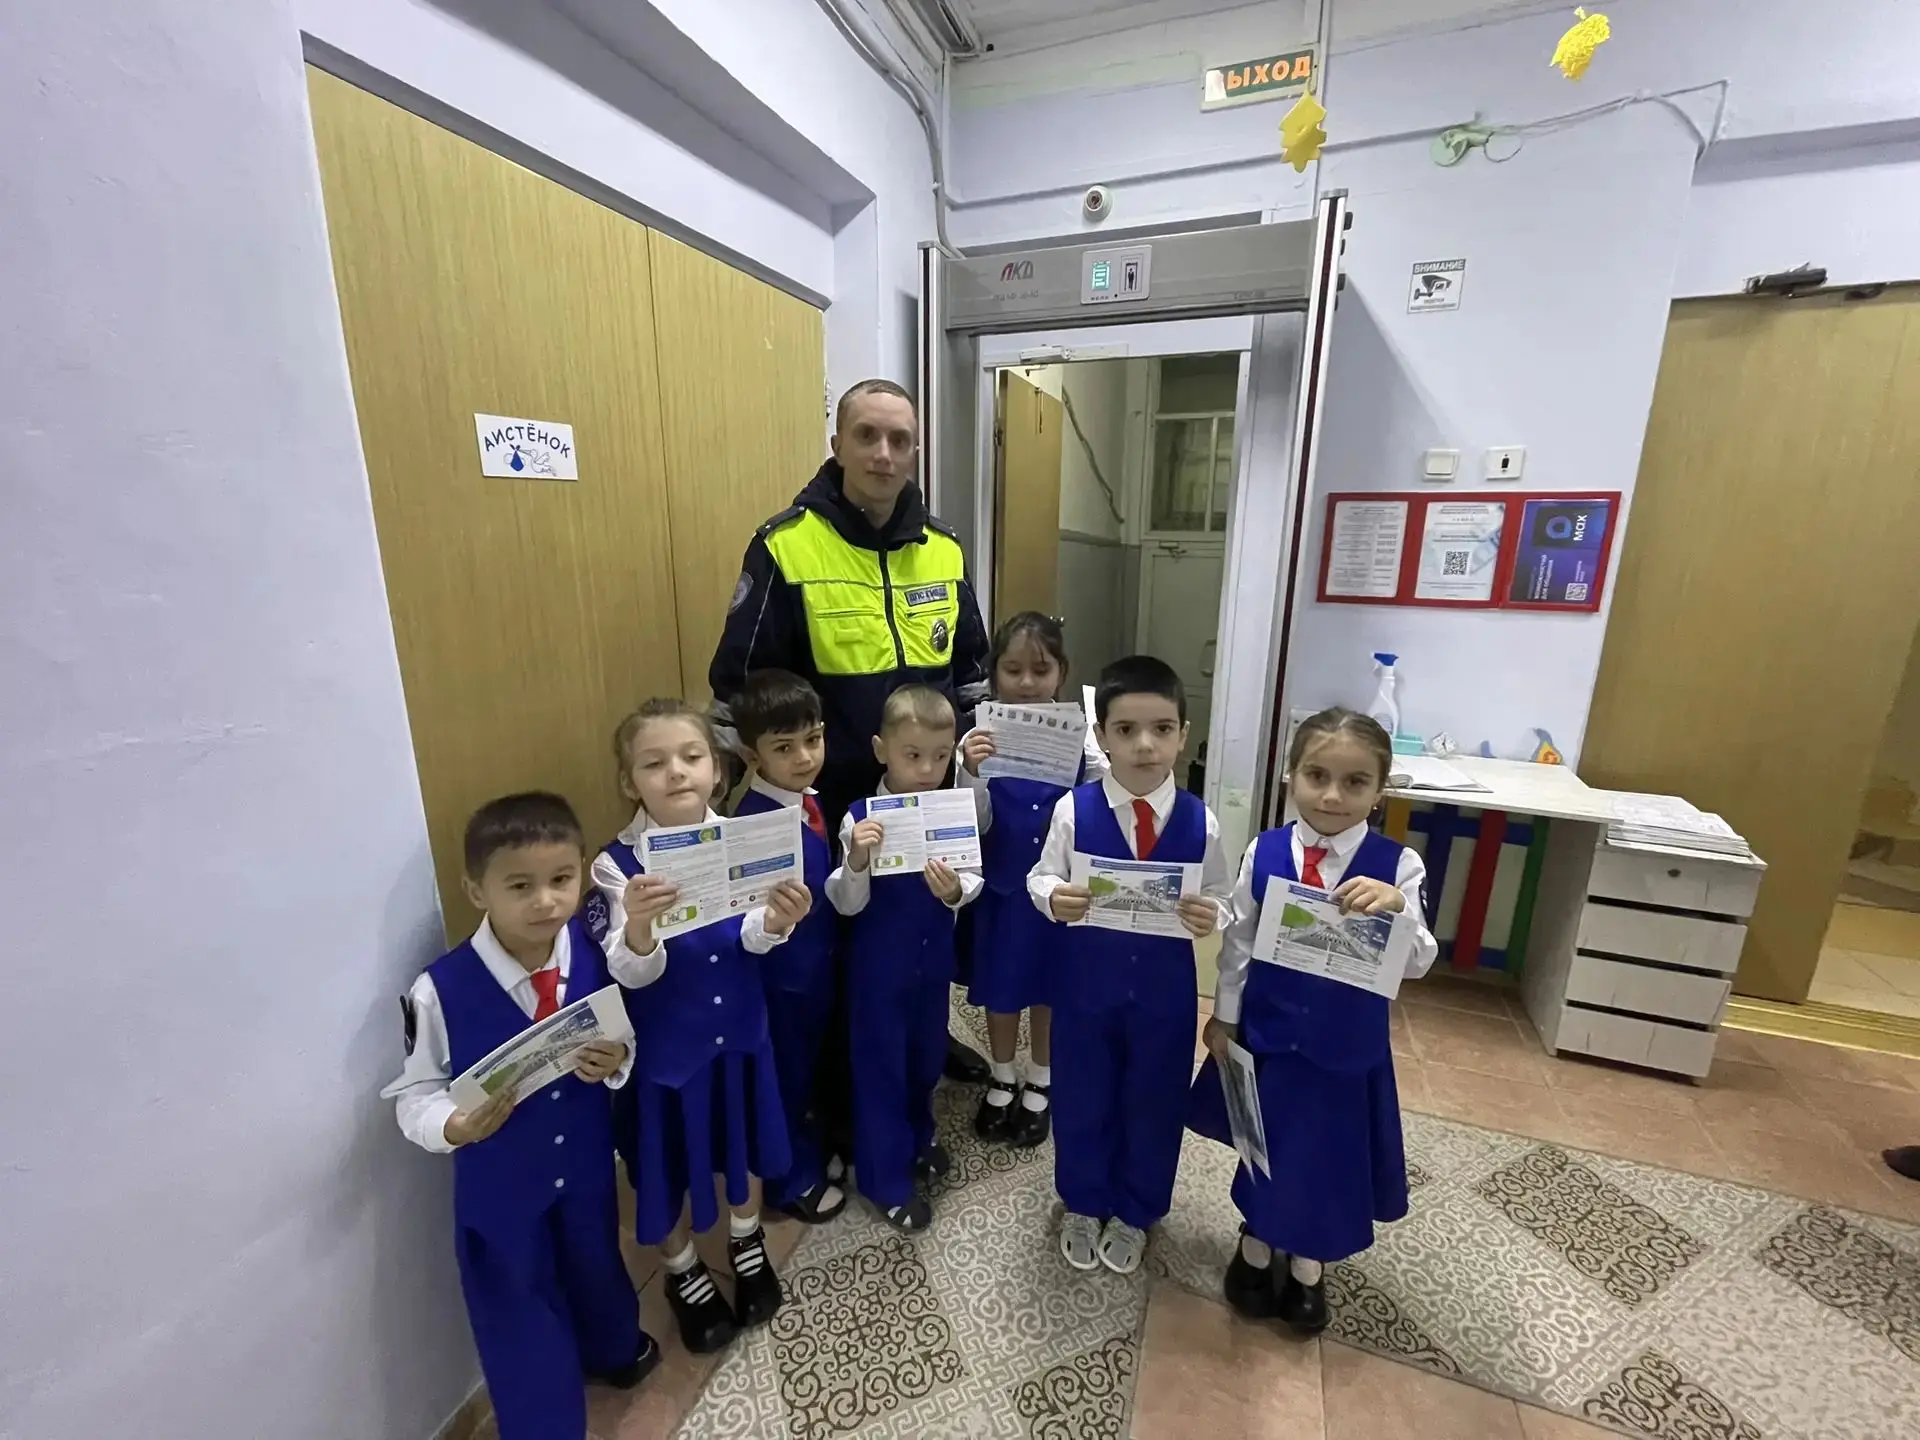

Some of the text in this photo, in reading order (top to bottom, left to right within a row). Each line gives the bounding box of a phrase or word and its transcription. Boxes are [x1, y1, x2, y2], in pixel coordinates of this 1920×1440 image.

[1226, 55, 1311, 90] ЫХОД
[1413, 260, 1464, 273] ВНИМАНИЕ
[484, 423, 571, 458] АИСТЁНОК
